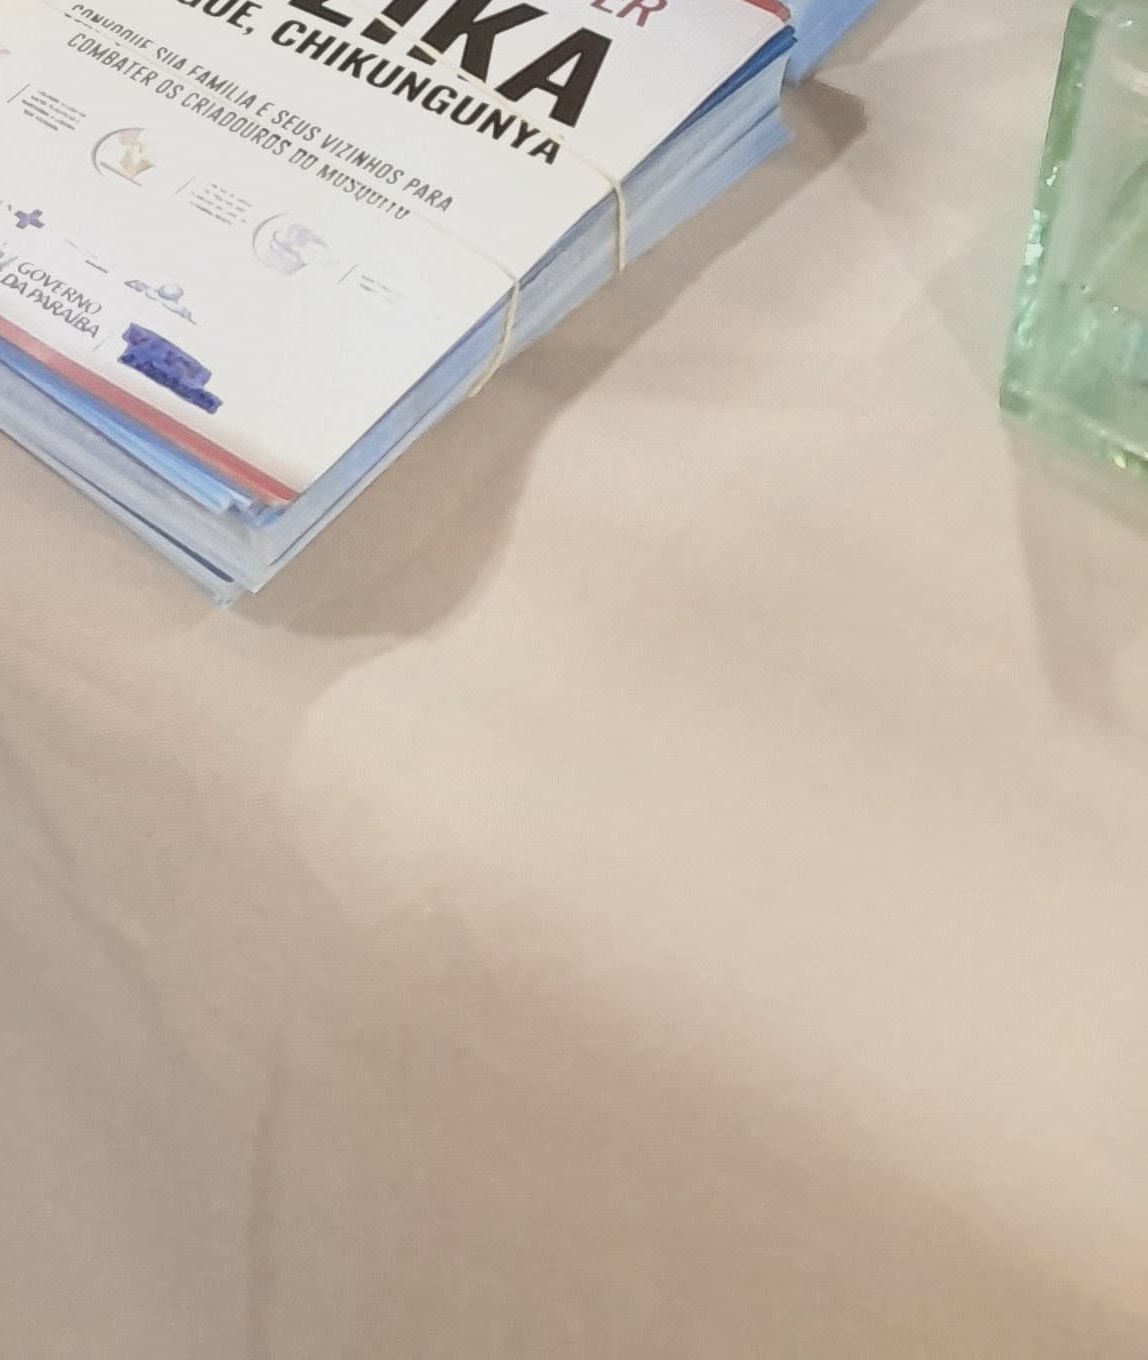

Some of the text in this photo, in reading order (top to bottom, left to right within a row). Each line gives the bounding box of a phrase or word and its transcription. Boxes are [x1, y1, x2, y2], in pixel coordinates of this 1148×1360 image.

[67, 32, 159, 87] COMBATER
[155, 78, 185, 100] OS
[180, 91, 293, 157] CRIADOUROS
[288, 147, 320, 171] DO
[270, 18, 563, 165] CHIKUNGUNYA
[255, 101, 276, 118] E
[271, 109, 322, 142] SEUS
[319, 133, 405, 185] VIZINHOS
[402, 177, 454, 212] PARA
[0, 272, 29, 295] DA
[17, 251, 103, 316] GOVERNO
